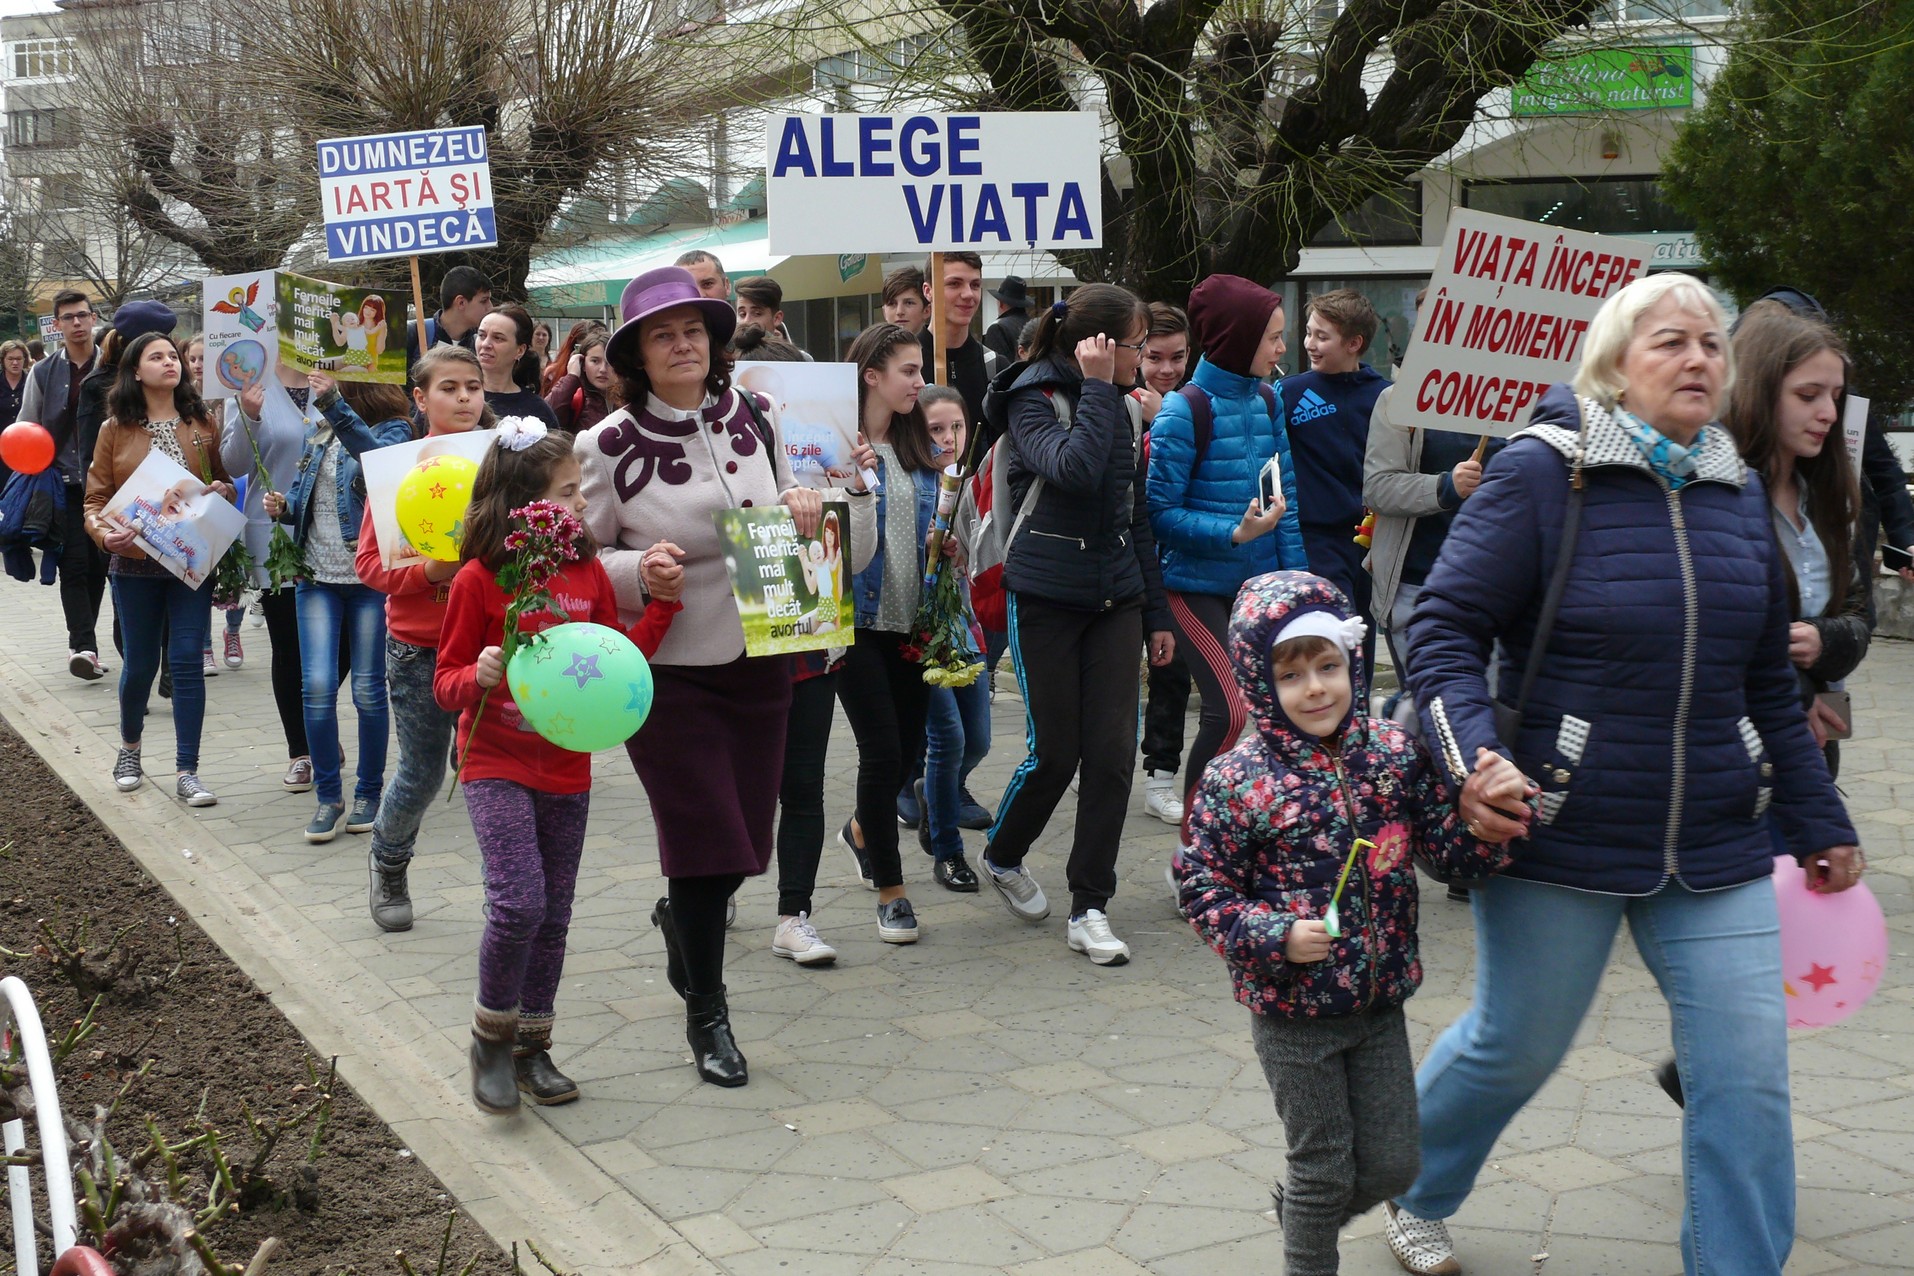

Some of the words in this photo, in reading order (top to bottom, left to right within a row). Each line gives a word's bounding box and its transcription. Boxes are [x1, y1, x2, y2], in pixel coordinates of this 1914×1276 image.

[1607, 80, 1685, 102] naturist
[321, 132, 485, 174] DUMNEZEU
[772, 116, 982, 177] ALEGE
[333, 169, 440, 215] IARTĂ
[902, 182, 1094, 249] VIAȚA
[336, 207, 487, 254] VINDECĂ
[1540, 234, 1642, 298] ÎNCEPE
[294, 288, 341, 307] Femeile
[294, 303, 333, 319] merită
[294, 316, 315, 329] mai
[1423, 287, 1465, 346] ÎN
[1462, 304, 1589, 362] MOMENT
[294, 329, 320, 344] mult
[295, 341, 325, 357] decât
[296, 354, 335, 371] avortul
[1290, 403, 1337, 426] adidas
[784, 443, 798, 456] 16
[801, 443, 822, 456] zile
[134, 495, 158, 516] Inima
[157, 513, 176, 530] mea
[135, 509, 147, 520] să
[172, 536, 184, 548] 16
[182, 543, 196, 558] zile
[143, 526, 153, 537] la
[758, 559, 786, 579] mai
[763, 578, 795, 598] mult
[766, 598, 803, 618] decât
[770, 617, 812, 638] avortul
